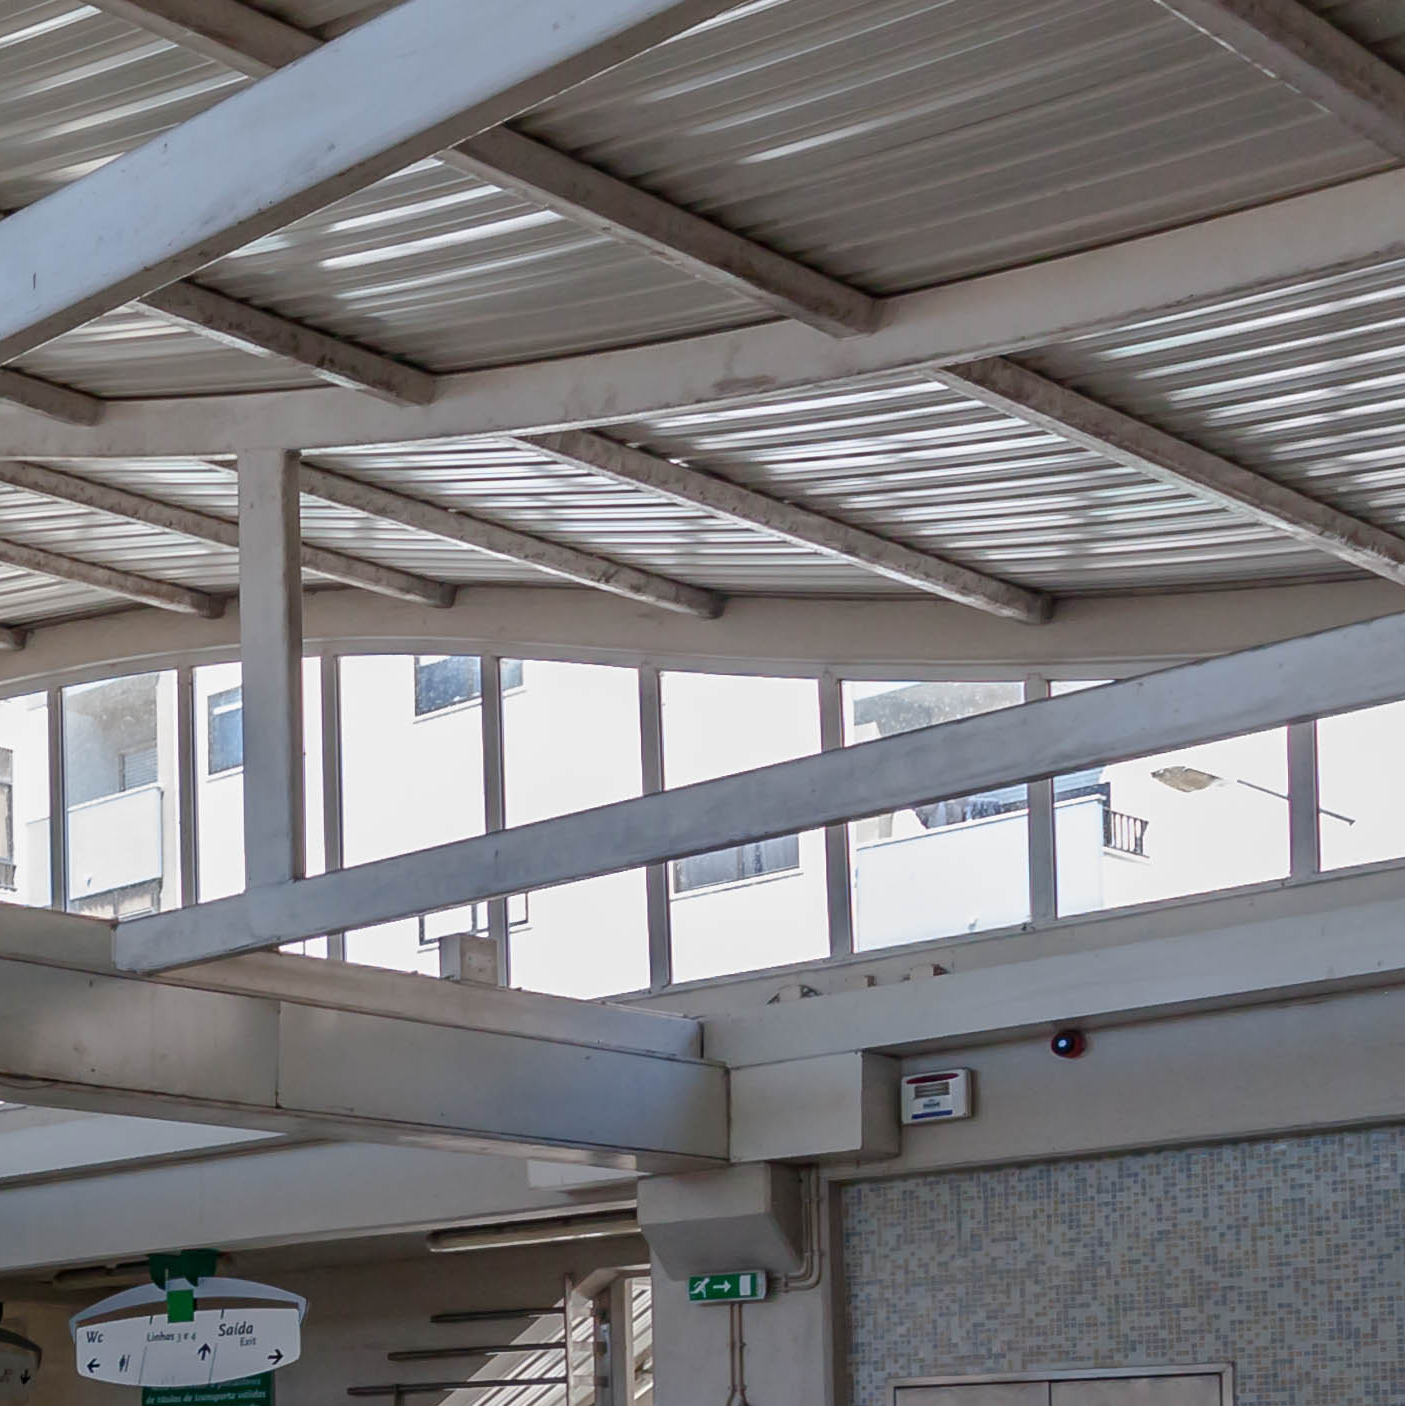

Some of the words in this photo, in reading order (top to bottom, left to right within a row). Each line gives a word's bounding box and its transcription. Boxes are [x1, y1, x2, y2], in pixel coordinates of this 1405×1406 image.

[218, 1322, 254, 1336] Saída
[146, 1330, 174, 1342] Linhas
[239, 1337, 256, 1346] Exit
